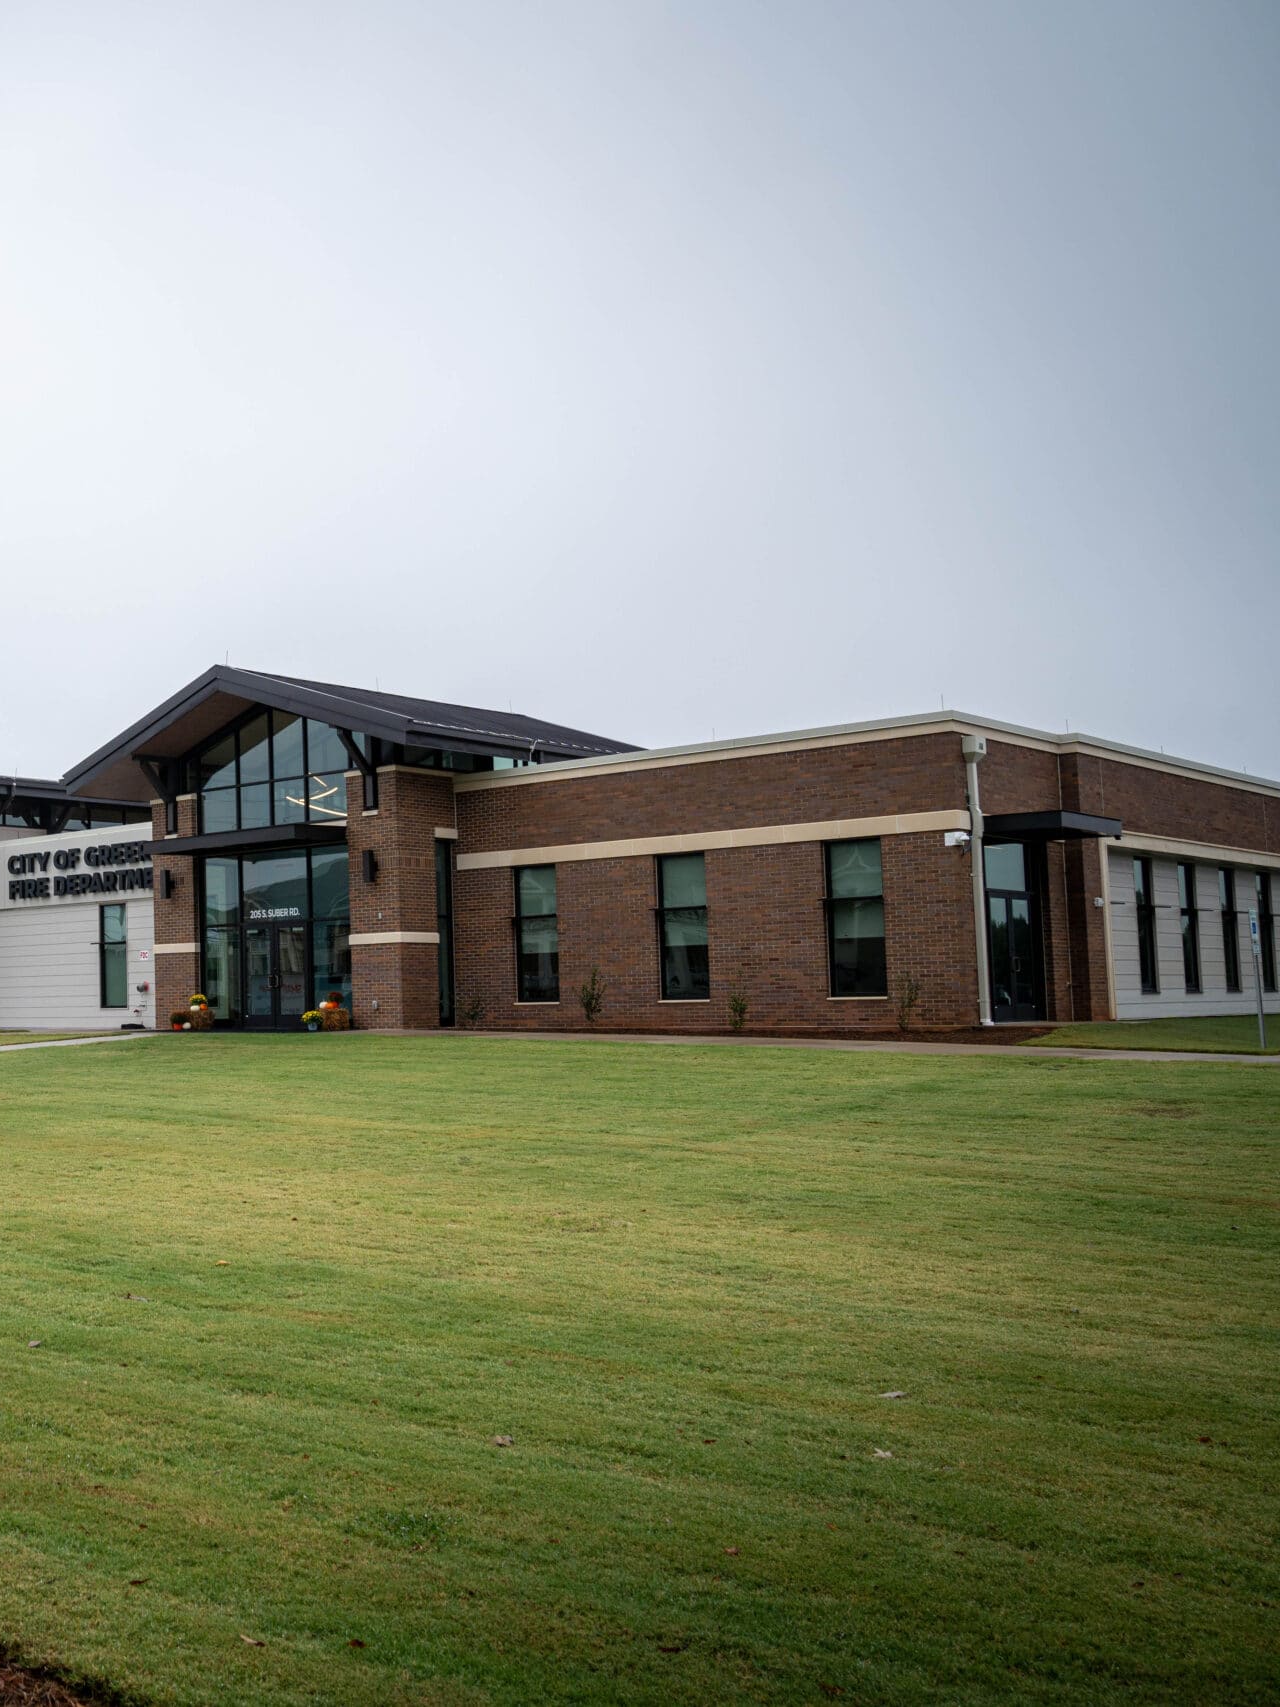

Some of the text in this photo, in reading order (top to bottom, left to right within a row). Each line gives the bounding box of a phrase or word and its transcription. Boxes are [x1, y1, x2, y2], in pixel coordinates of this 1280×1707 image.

[7, 851, 51, 875] CITY
[53, 847, 81, 870] OF
[8, 877, 51, 900] FIRE
[250, 910, 261, 919] 205
[268, 908, 289, 917] SUBER
